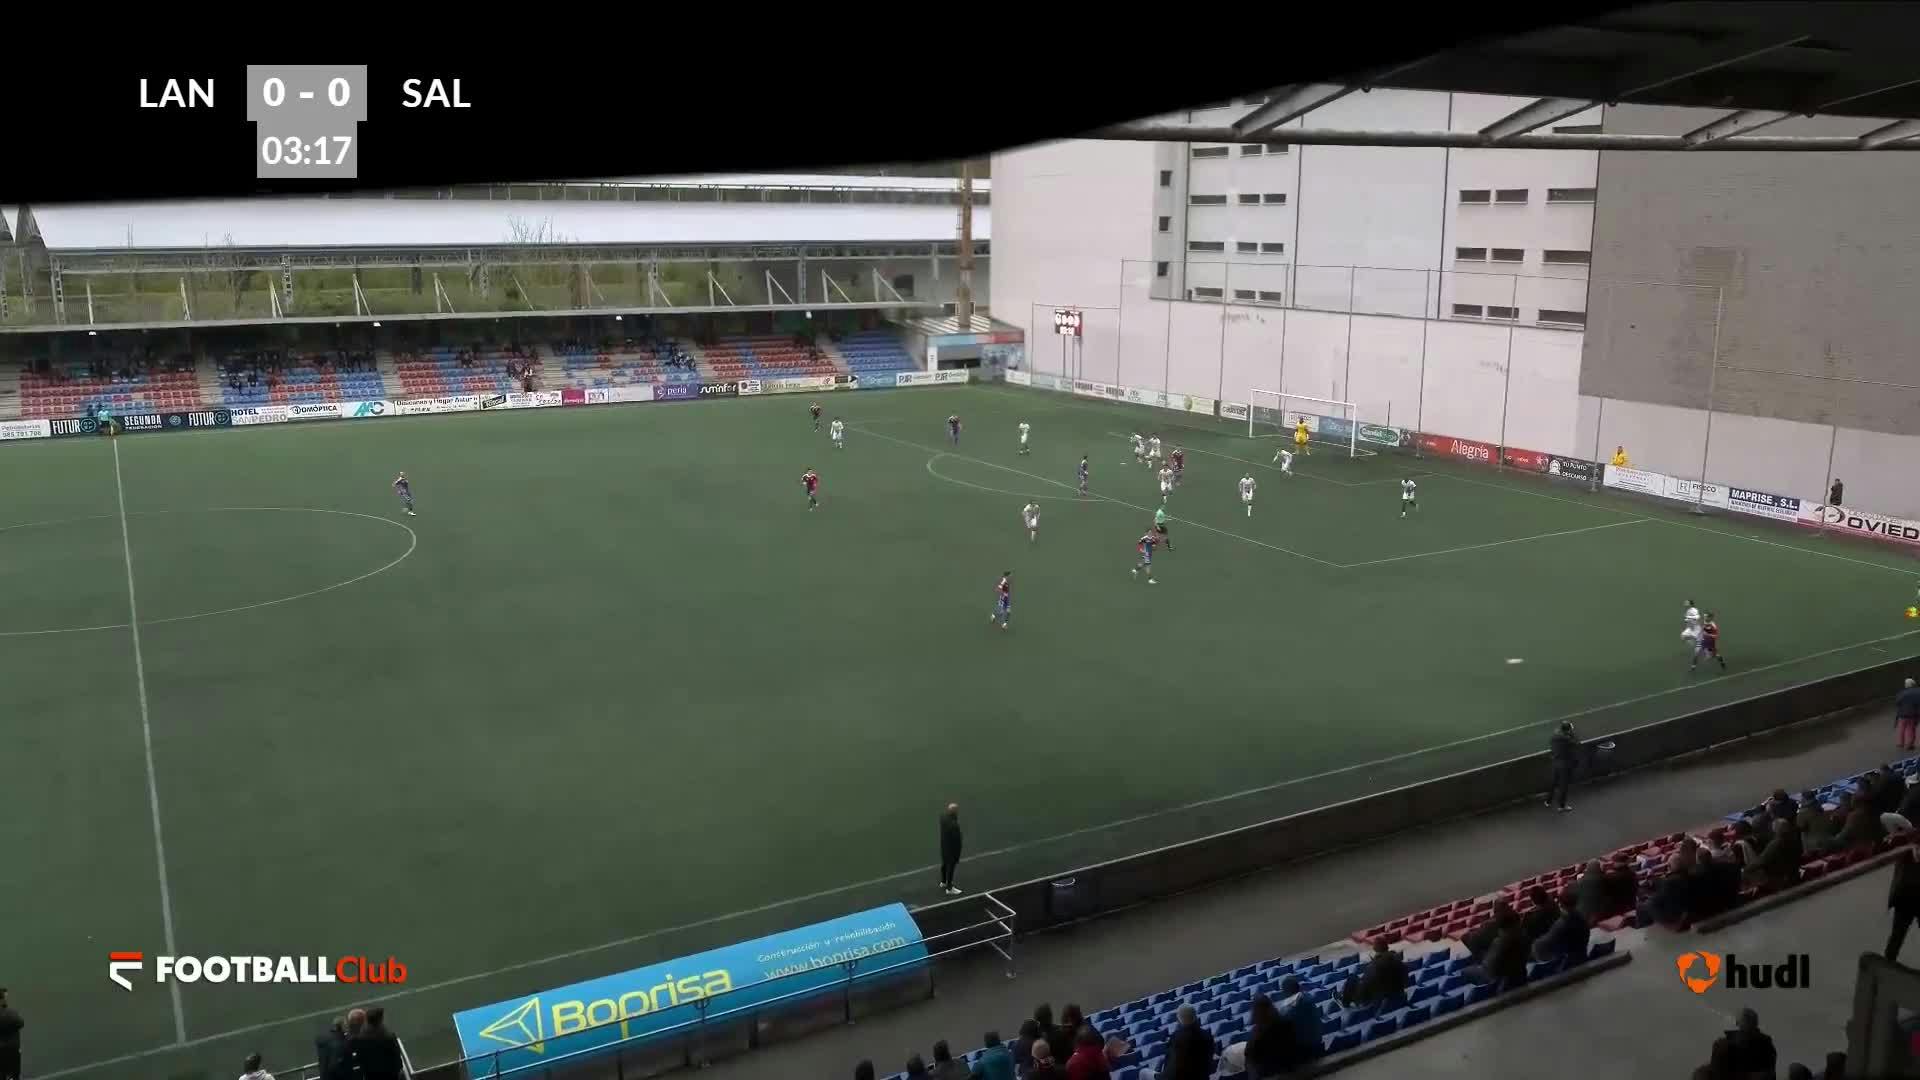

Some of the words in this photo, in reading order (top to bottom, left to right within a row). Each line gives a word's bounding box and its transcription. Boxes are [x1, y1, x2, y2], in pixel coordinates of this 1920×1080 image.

[124, 414, 162, 426] SEGUNDA
[231, 408, 259, 416] HOTEL
[1450, 440, 1489, 460] Alegría
[1780, 498, 1798, 509] S.L.
[758, 941, 821, 963] Construcción
[835, 922, 897, 945] rehabilitación
[552, 968, 733, 1040] Boprisa
